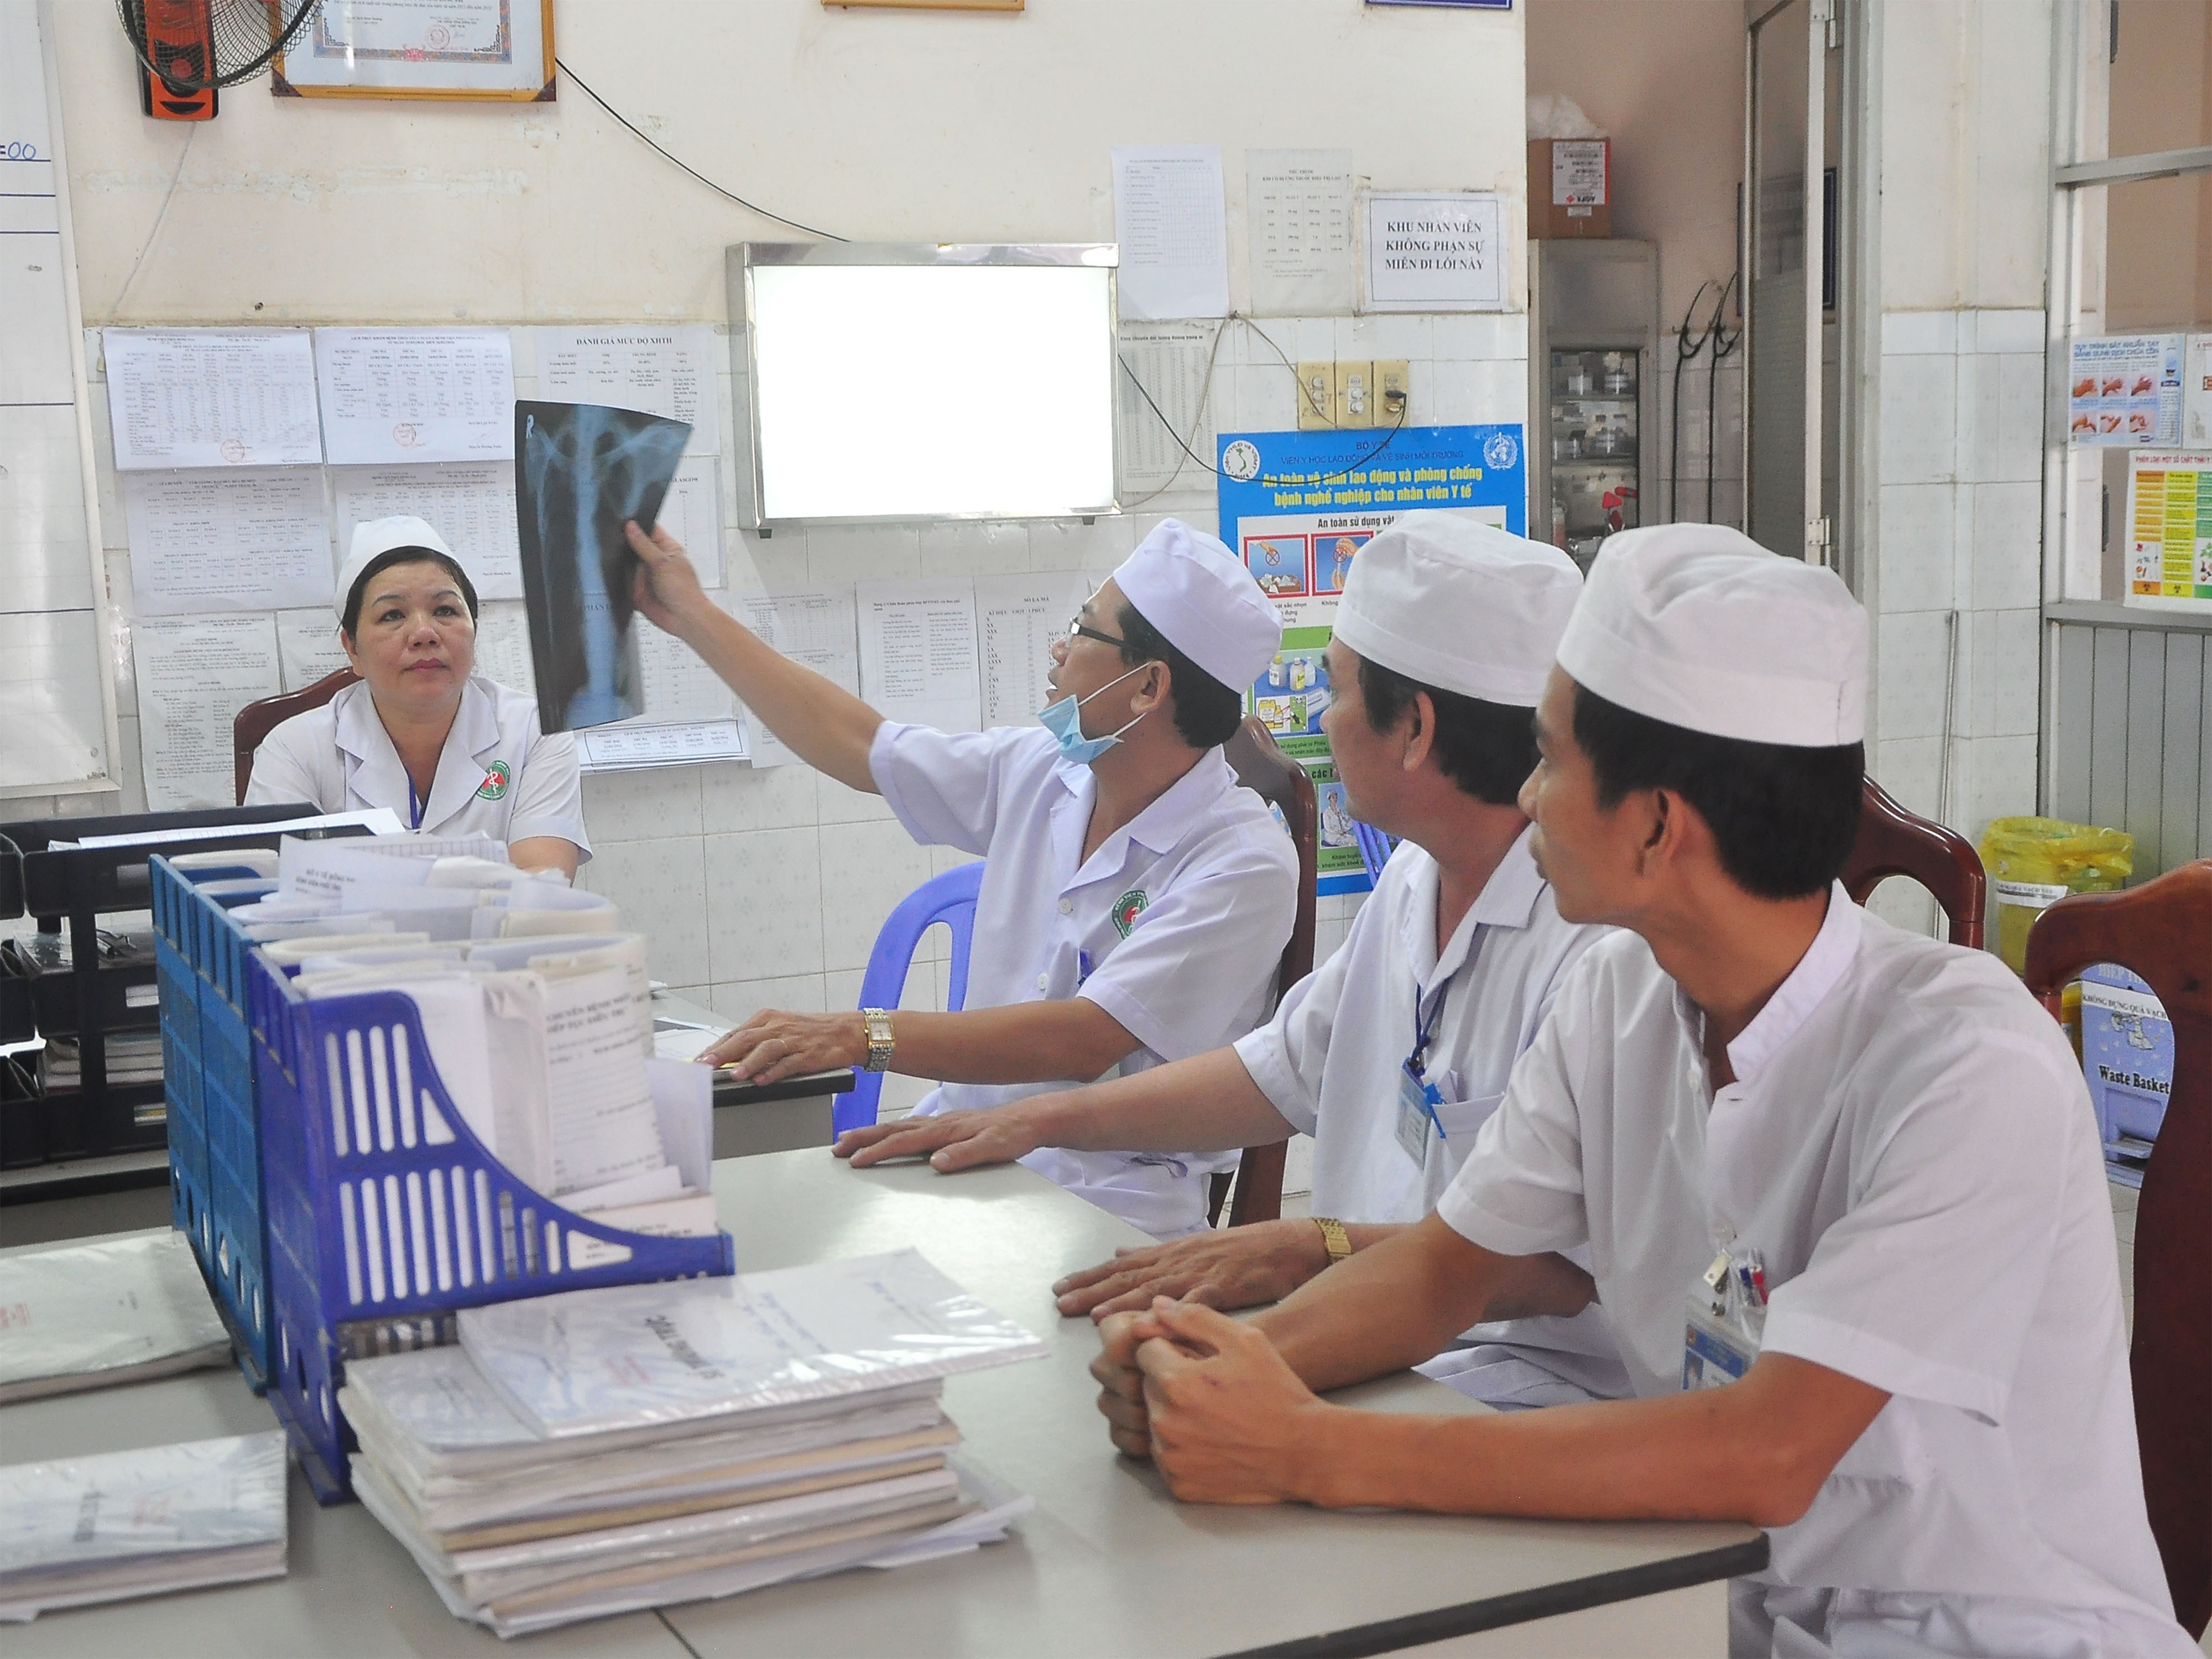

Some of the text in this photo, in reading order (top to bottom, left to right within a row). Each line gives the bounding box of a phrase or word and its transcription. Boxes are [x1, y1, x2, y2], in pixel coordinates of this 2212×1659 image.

[1387, 220, 1481, 232] KHU NHÂN VIÊN
[1386, 238, 1430, 251] KHÔNG
[1469, 240, 1485, 254] SỰ
[576, 337, 599, 345] ĐÁNH
[1356, 441, 1369, 451] BỘ
[1262, 463, 1483, 489] An toàn vệ sinh lao động và phòng chống
[1274, 482, 1473, 509] bệnh nghề nghiệp cho nhân viên Y tế
[1318, 518, 1327, 528] An
[1331, 517, 1348, 528] toàn
[1350, 516, 1359, 526] sử
[1361, 517, 1380, 528] dụng
[1312, 768, 1328, 779] các
[2099, 1065, 2169, 1094] Waste Basket
